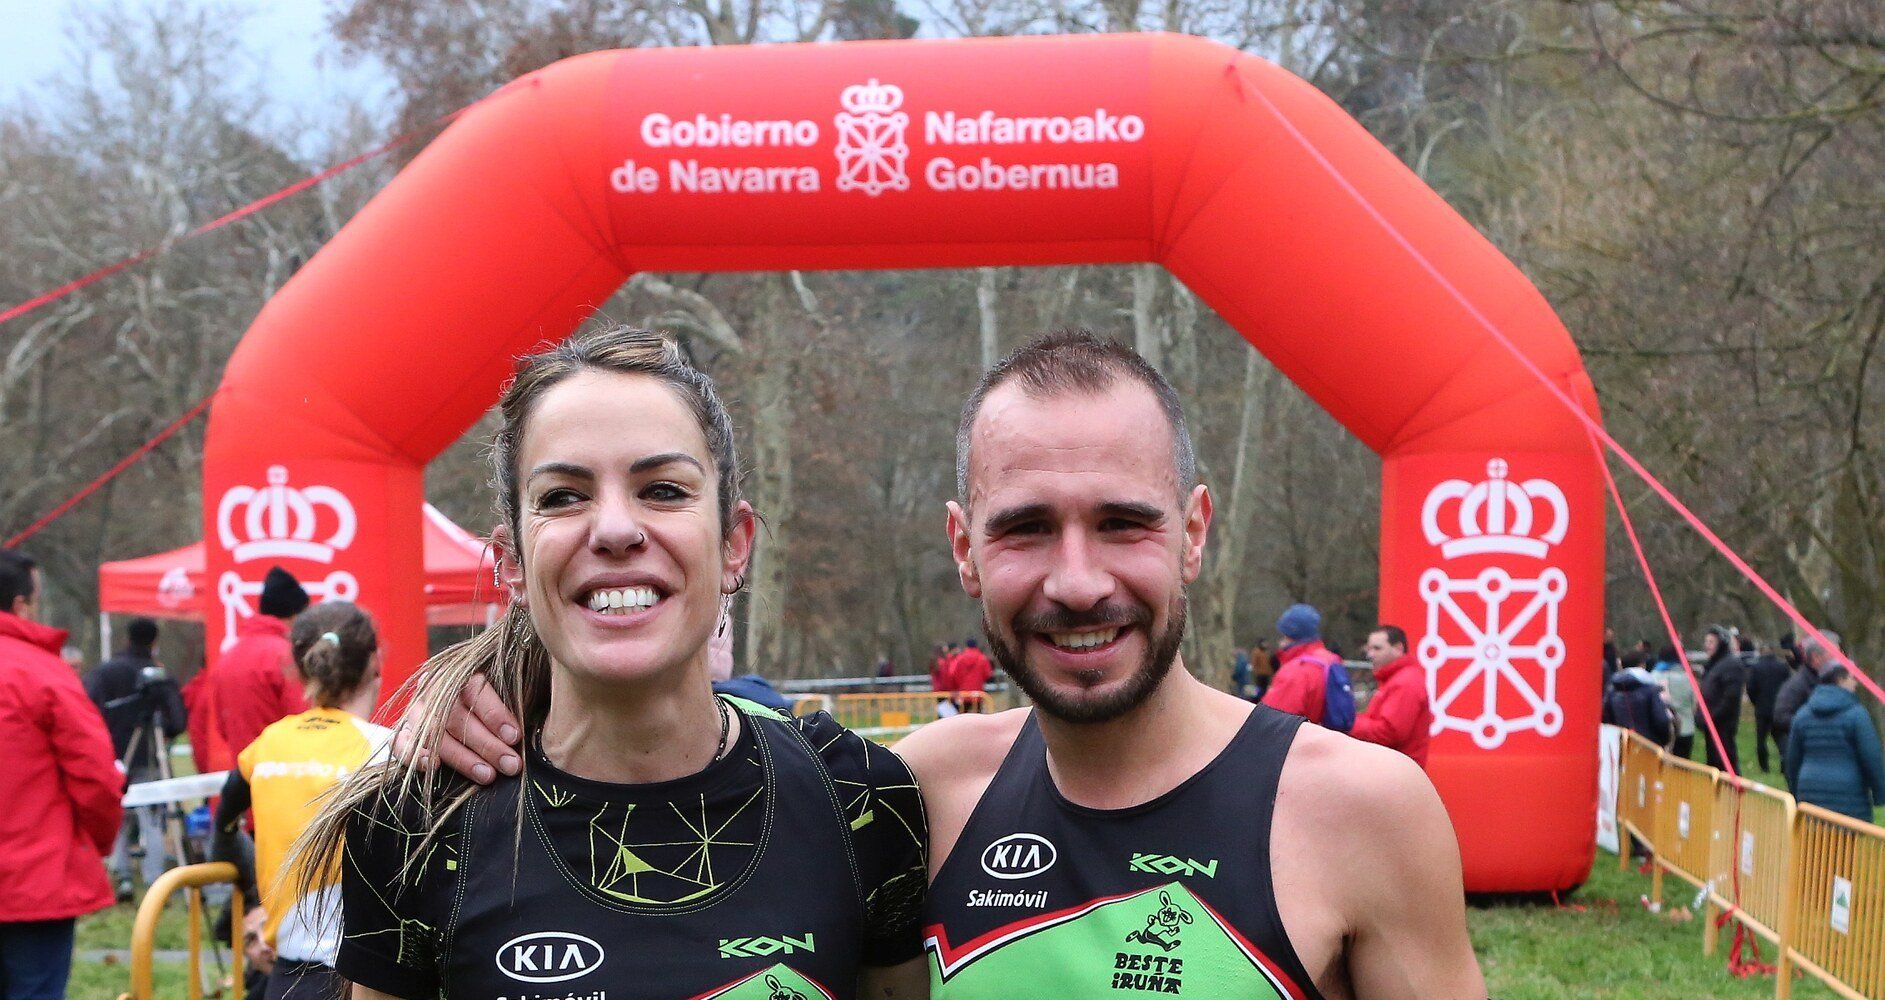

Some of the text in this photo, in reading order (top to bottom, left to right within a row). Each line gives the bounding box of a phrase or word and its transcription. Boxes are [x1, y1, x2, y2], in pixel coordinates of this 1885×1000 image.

[641, 112, 819, 147] Gobierno
[925, 108, 1144, 144] Nafarroako
[610, 159, 821, 193] de Navarra
[925, 157, 1119, 191] Gobernua
[991, 844, 1040, 869] KIA
[1129, 852, 1218, 879] KON
[966, 889, 1048, 909] Sakimóvil
[513, 943, 586, 972] KIA
[717, 932, 815, 959] KON
[1114, 952, 1183, 975] BESTE
